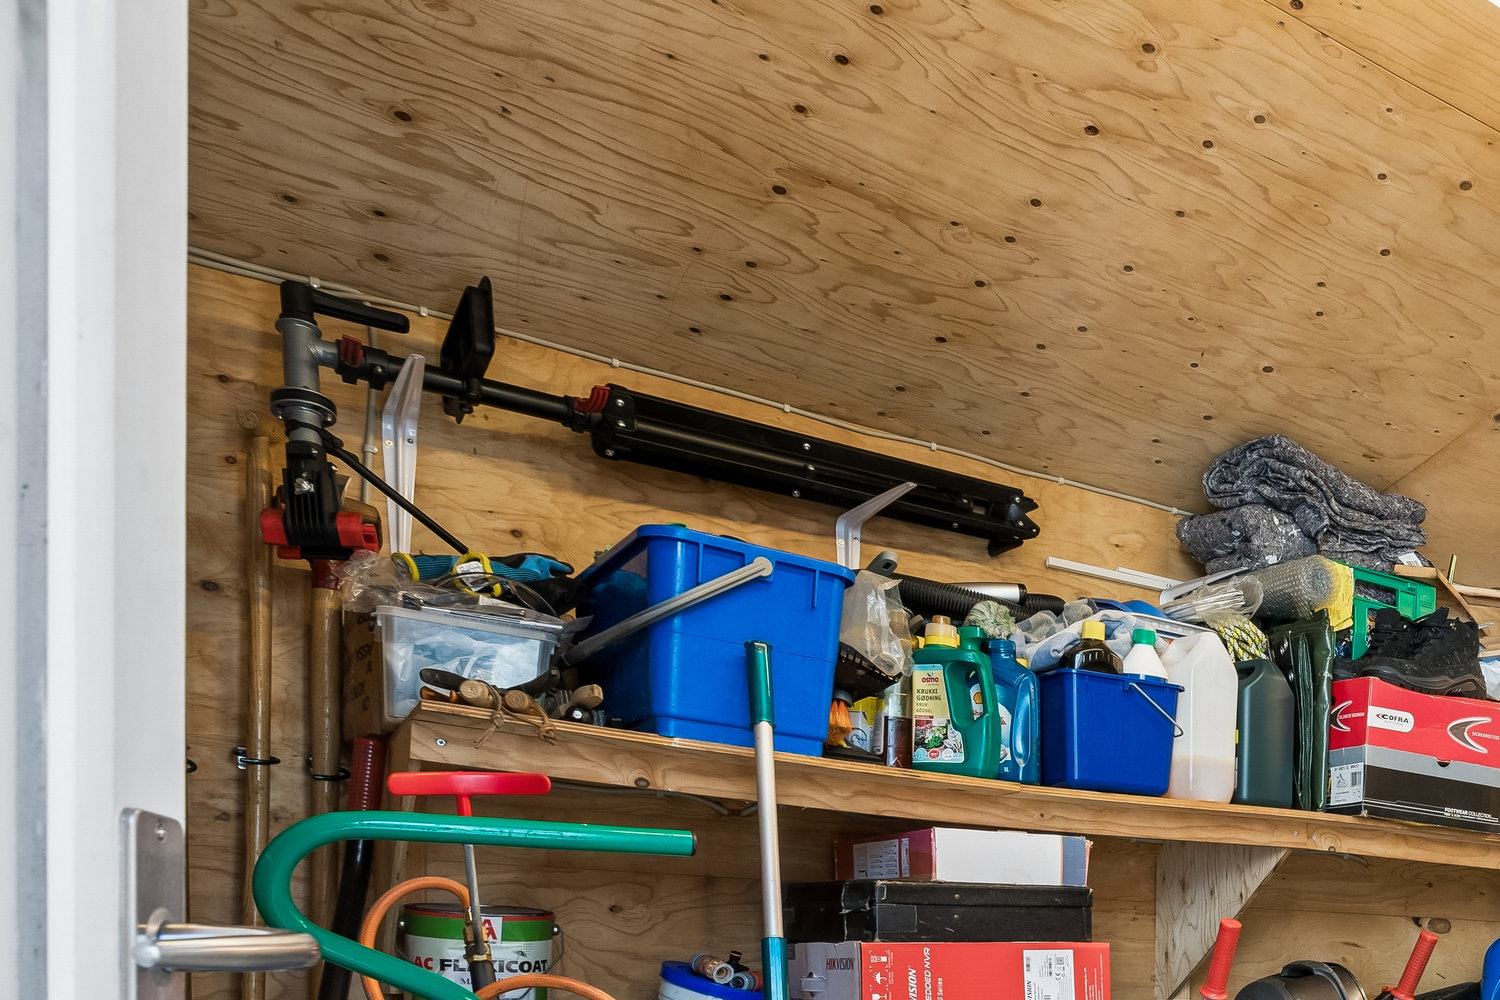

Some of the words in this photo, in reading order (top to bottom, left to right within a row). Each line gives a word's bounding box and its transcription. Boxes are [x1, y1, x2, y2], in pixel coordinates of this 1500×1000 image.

[1381, 714, 1409, 724] COFRA
[414, 956, 433, 971] AC
[826, 958, 855, 971] HIKVISION
[923, 946, 931, 969] NVR
